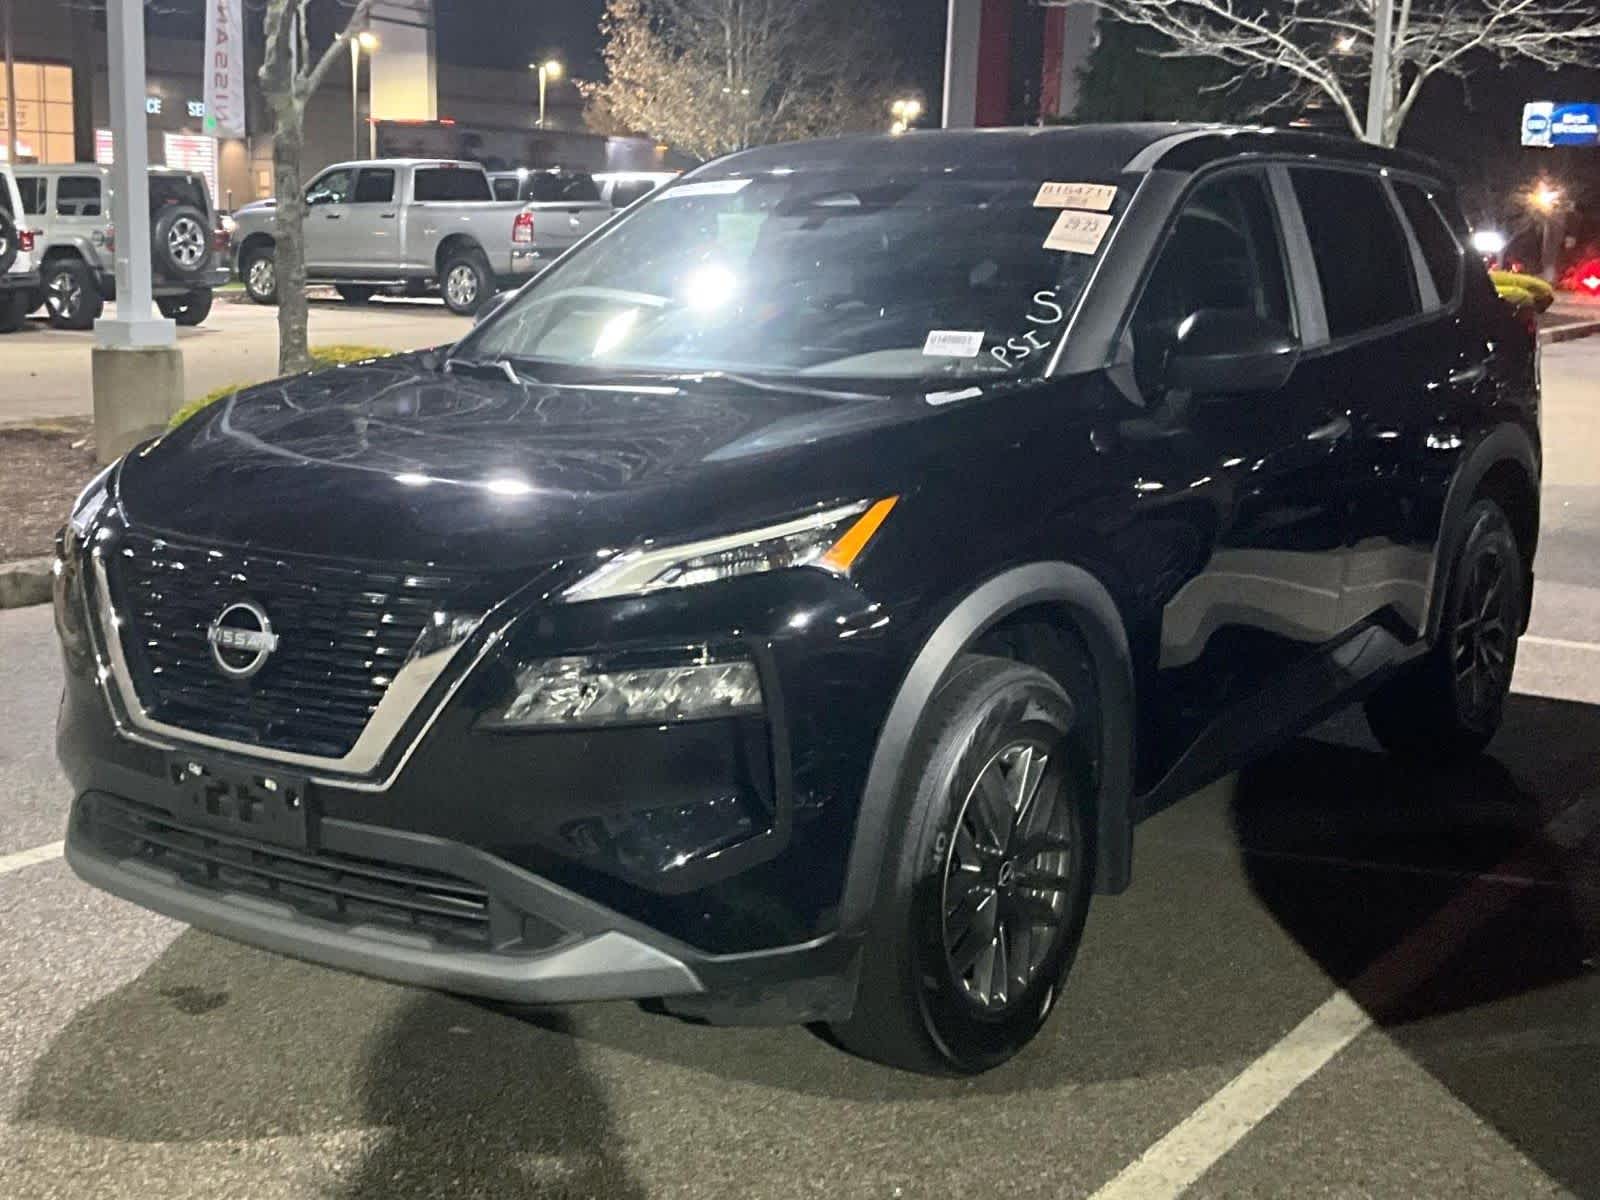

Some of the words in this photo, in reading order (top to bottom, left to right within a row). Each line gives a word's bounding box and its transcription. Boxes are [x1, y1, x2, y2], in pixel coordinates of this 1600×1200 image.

[144, 98, 162, 114] CE
[186, 101, 206, 117] SE
[1025, 290, 1062, 324] S
[990, 329, 1051, 368] PSI
